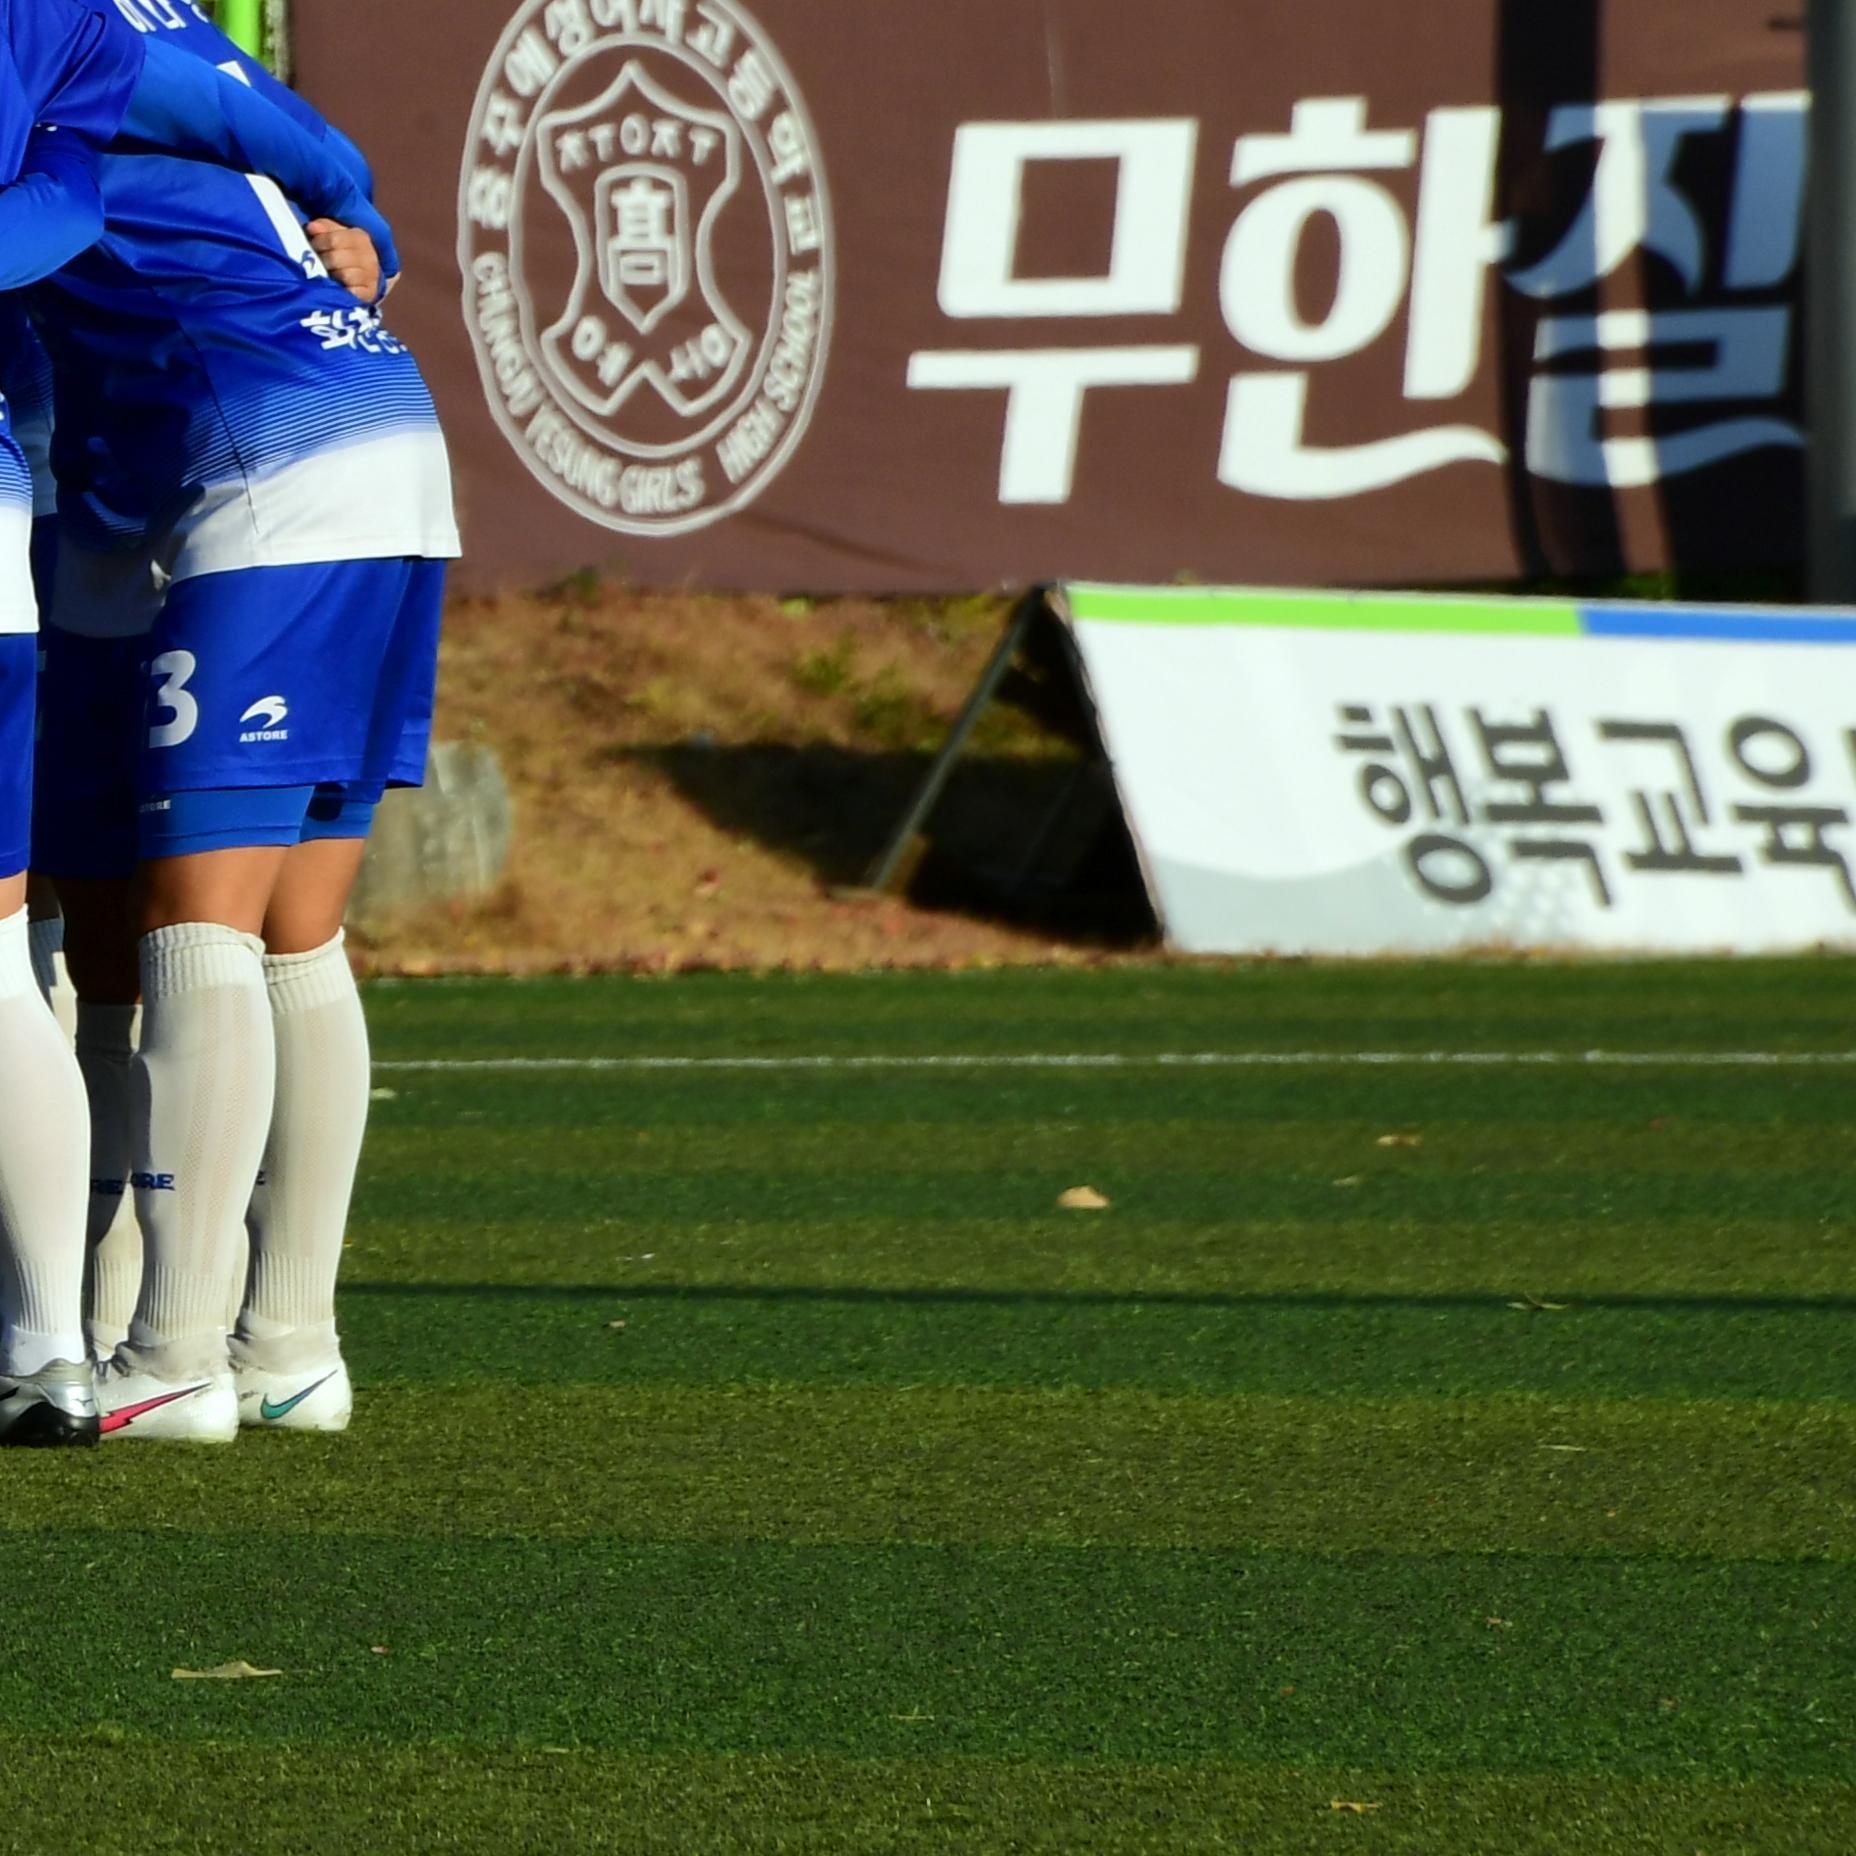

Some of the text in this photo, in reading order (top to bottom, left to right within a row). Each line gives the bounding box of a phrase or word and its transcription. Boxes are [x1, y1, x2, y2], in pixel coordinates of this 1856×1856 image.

[715, 396, 786, 484] HIGH
[763, 268, 819, 413] SCHOOL
[239, 729, 288, 743] ASTORE
[1334, 699, 1856, 912] 행복교육
